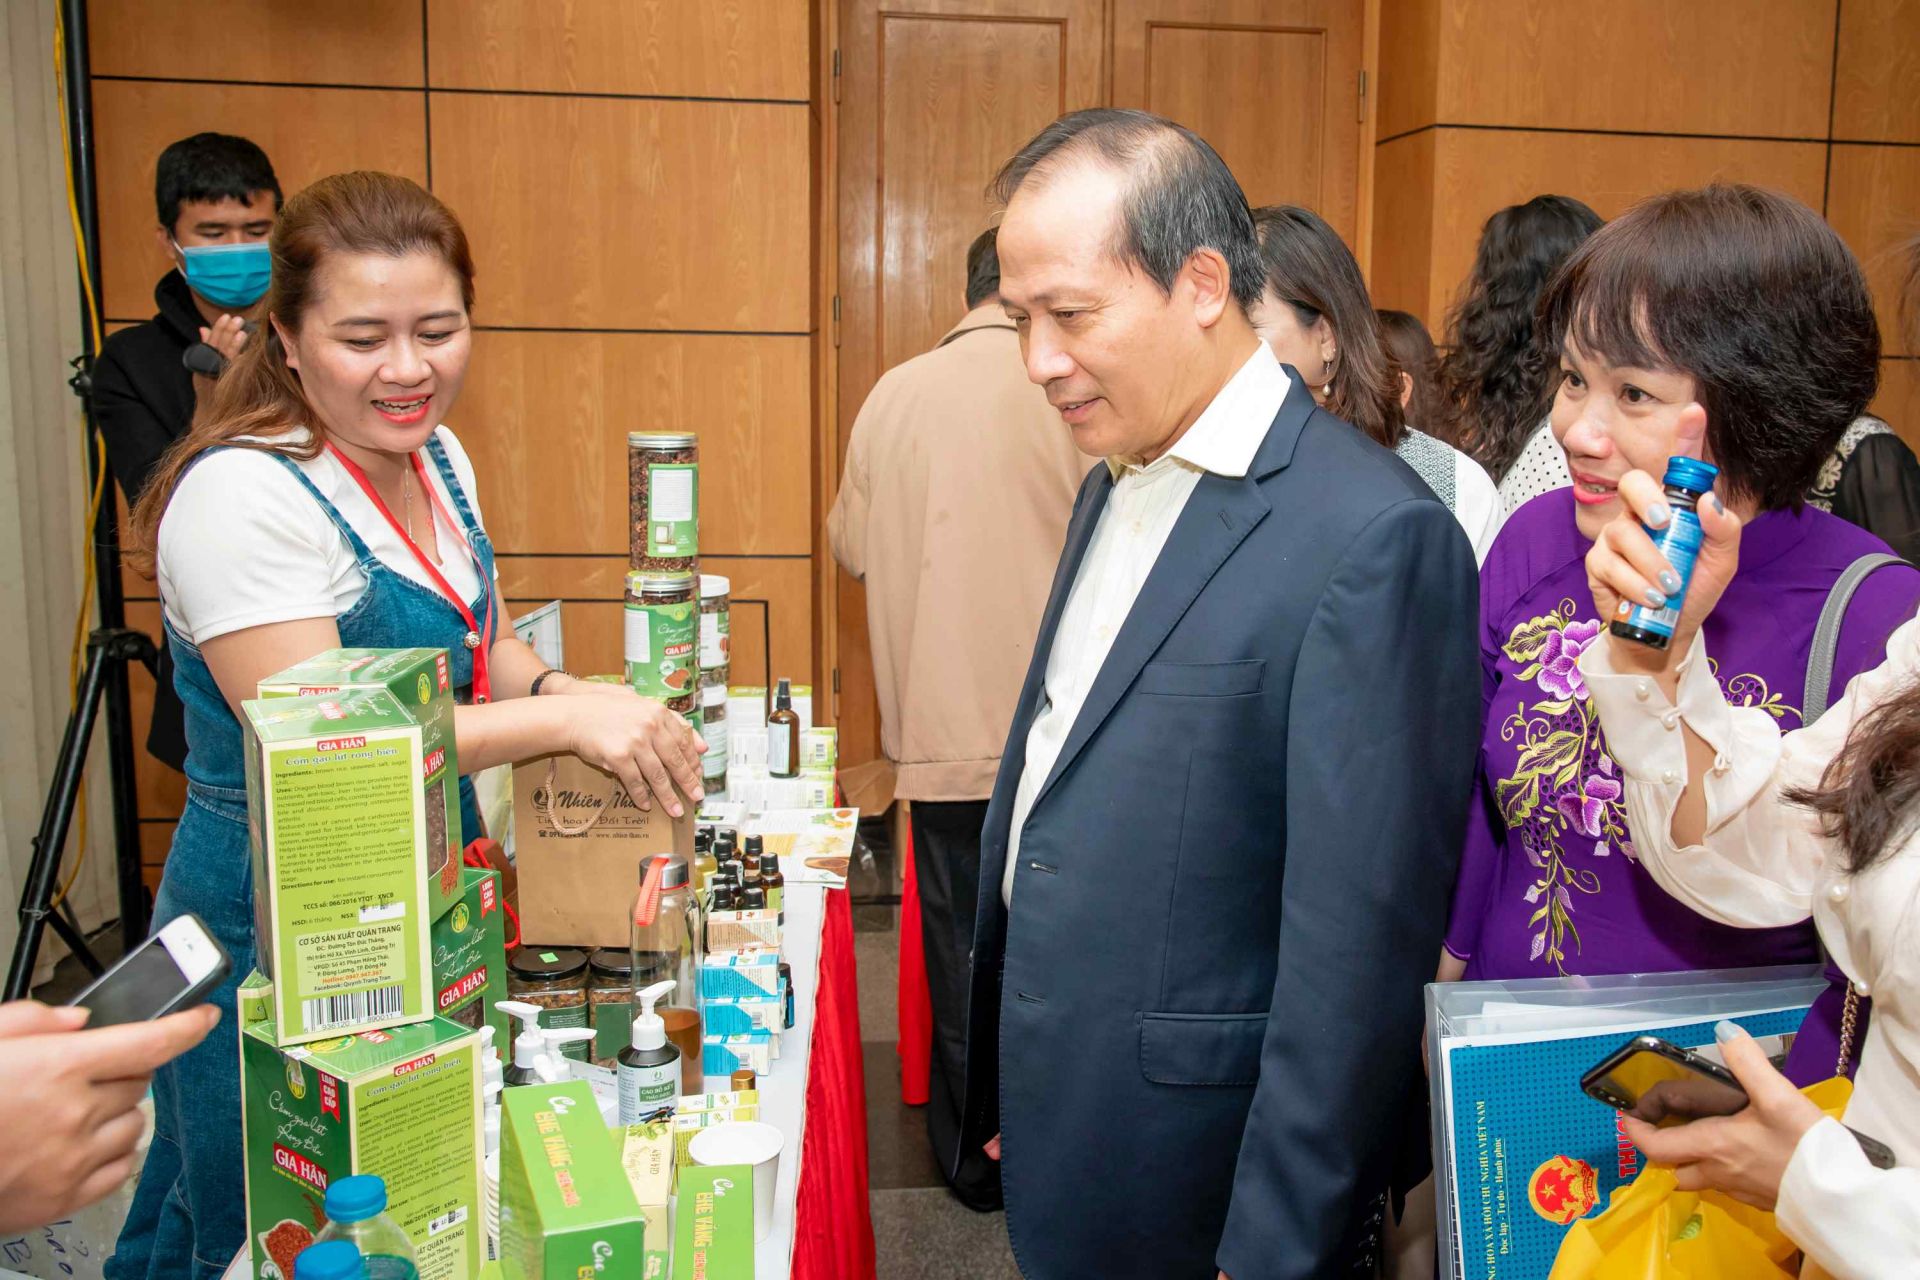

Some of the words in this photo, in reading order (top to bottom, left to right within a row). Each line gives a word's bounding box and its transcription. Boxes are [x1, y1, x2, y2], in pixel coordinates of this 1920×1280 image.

[665, 647, 680, 655] GIA
[319, 741, 338, 751] GIA
[341, 738, 365, 749] HÂN
[275, 769, 314, 779] Ingredients:
[557, 790, 603, 809] Nhiên
[563, 815, 583, 825] hoa
[280, 880, 313, 890] Directions
[298, 936, 310, 946] CƠ
[356, 926, 377, 939] QUÂN
[378, 924, 402, 935] TRANG
[440, 987, 461, 1008] GIA
[463, 969, 486, 996] HÂN
[395, 1064, 411, 1077] GIA
[414, 1055, 435, 1070] HÂN
[1475, 1099, 1486, 1124] NAM
[1476, 1124, 1489, 1149] VIỆT
[275, 1149, 298, 1174] GIA
[300, 1162, 327, 1190] HÂN
[1477, 1149, 1491, 1183] NGHĨA
[1496, 1189, 1506, 1202] do
[445, 1228, 465, 1243] TRANG
